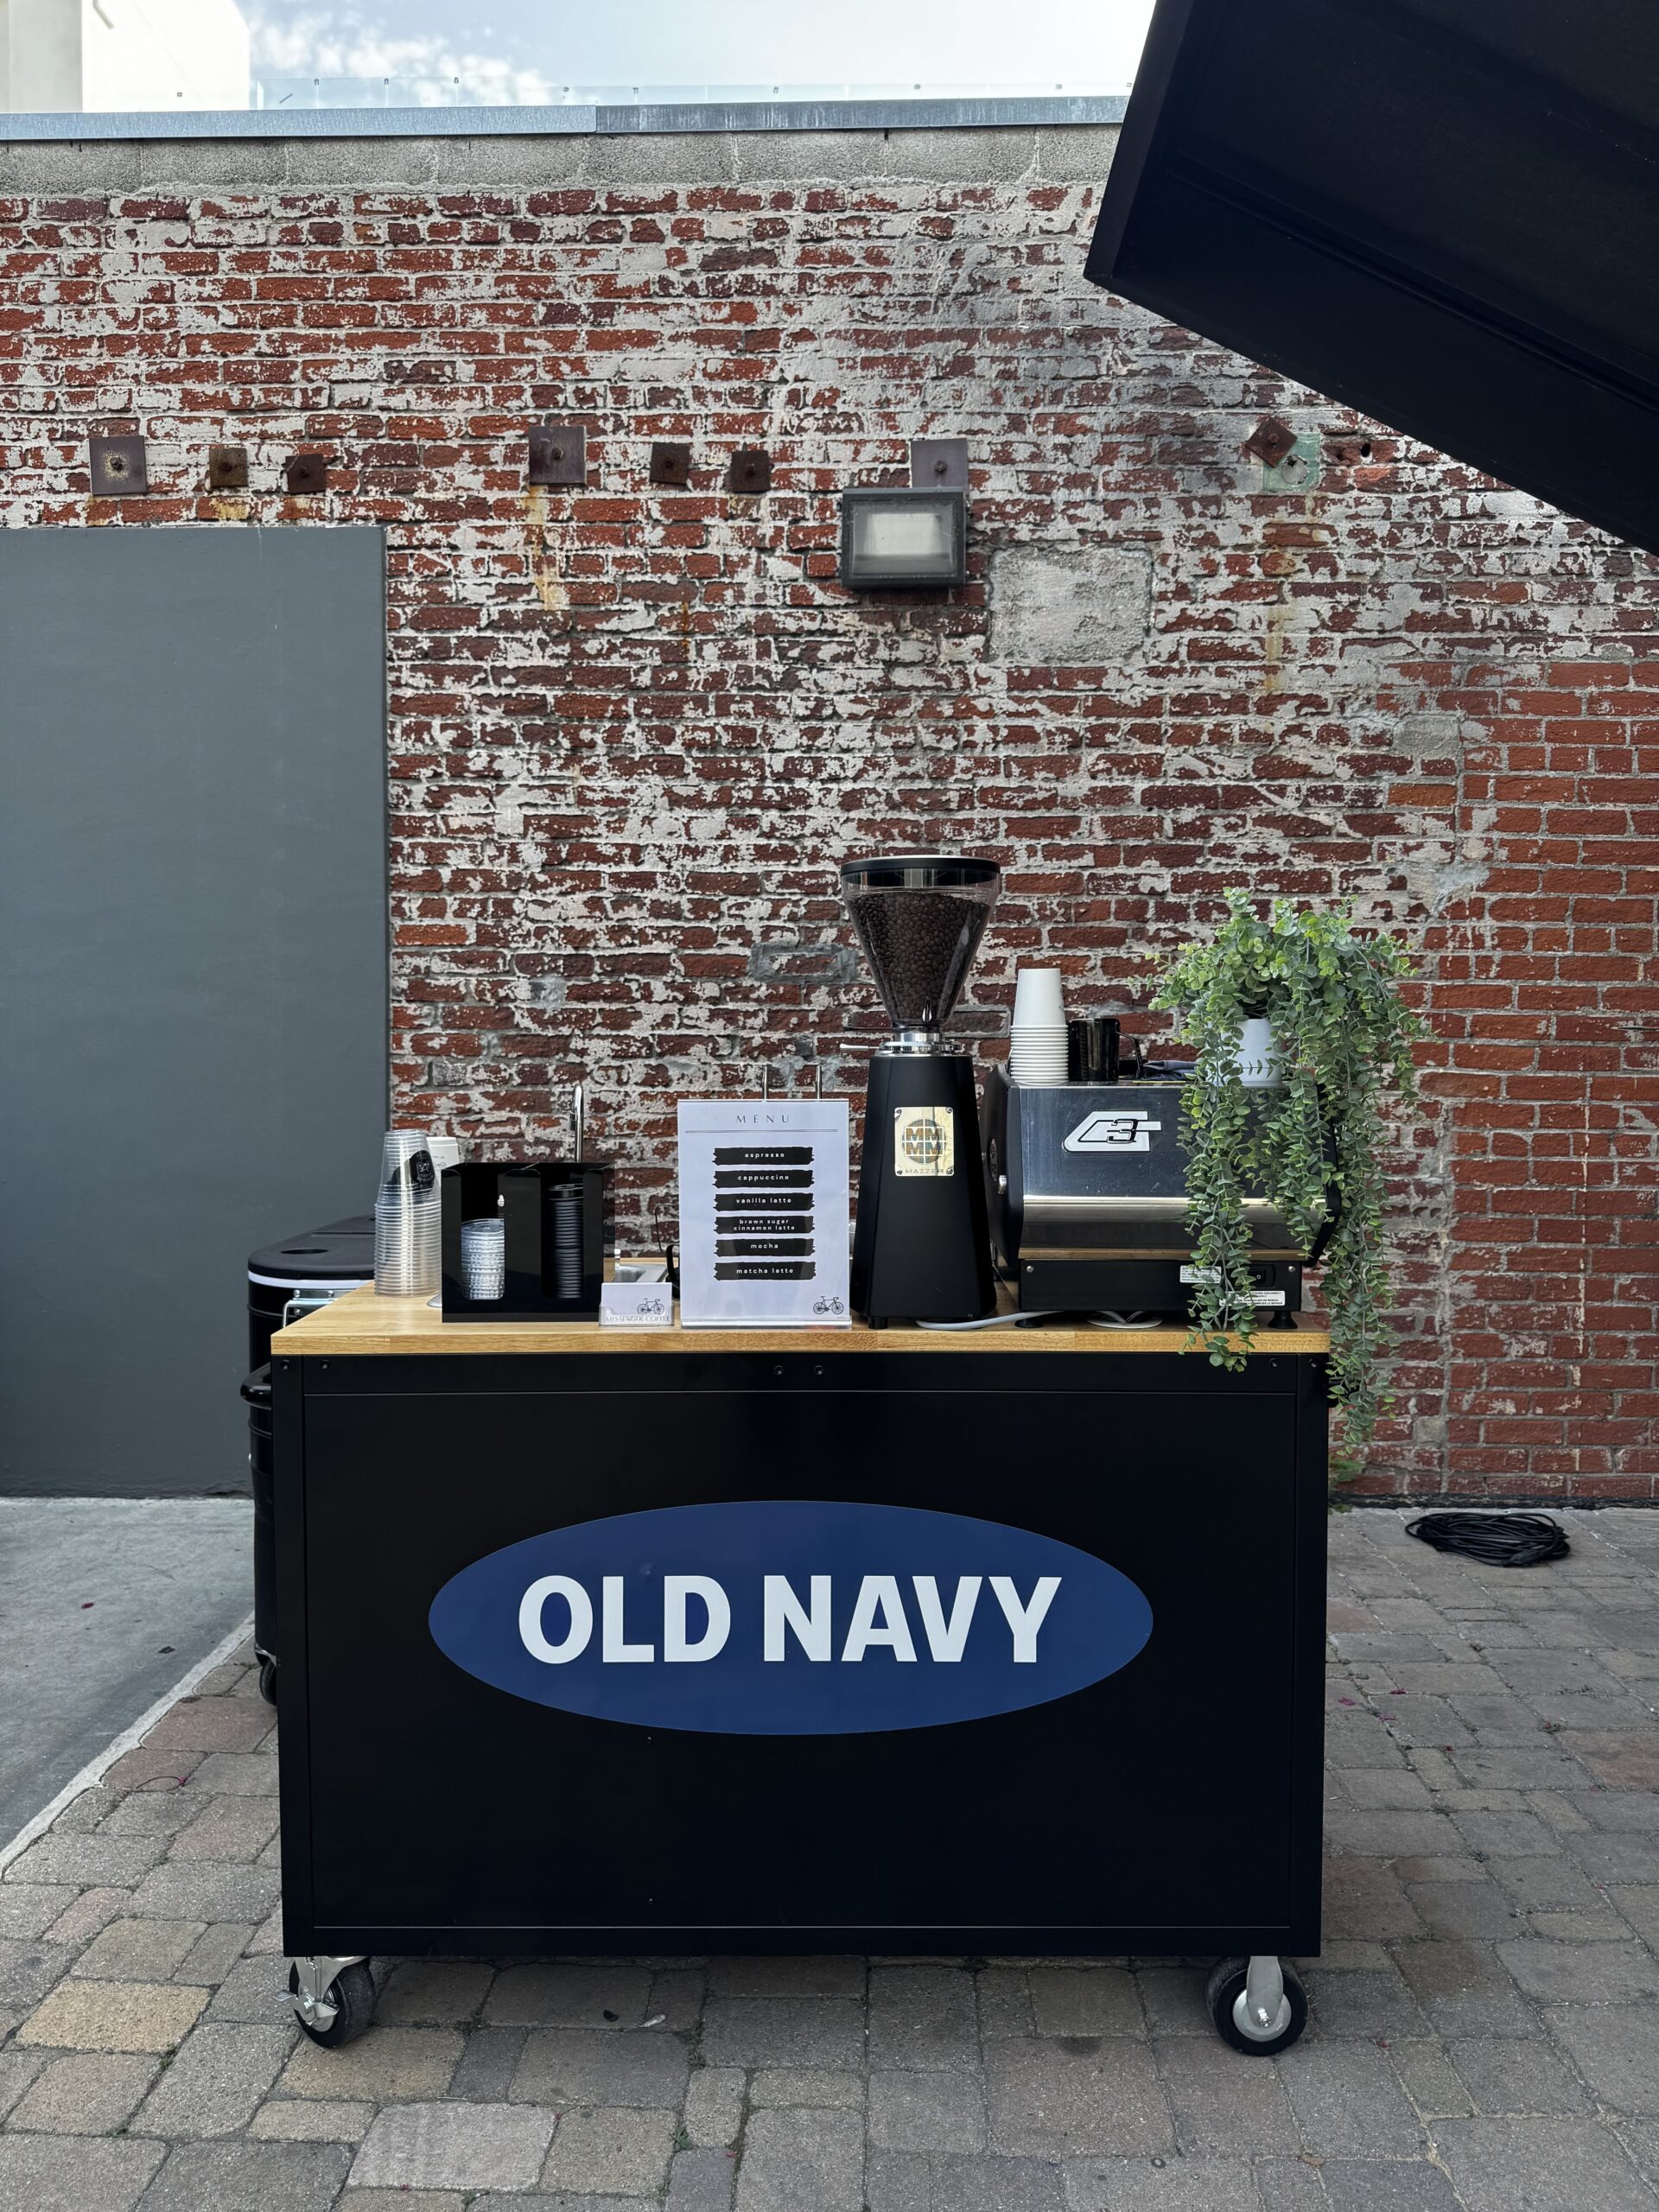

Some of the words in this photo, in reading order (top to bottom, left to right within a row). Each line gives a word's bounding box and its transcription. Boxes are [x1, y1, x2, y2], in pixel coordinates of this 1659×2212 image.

[735, 1114, 790, 1123] MENU
[518, 1574, 731, 1664] OLD
[763, 1574, 1062, 1664] NAVY
